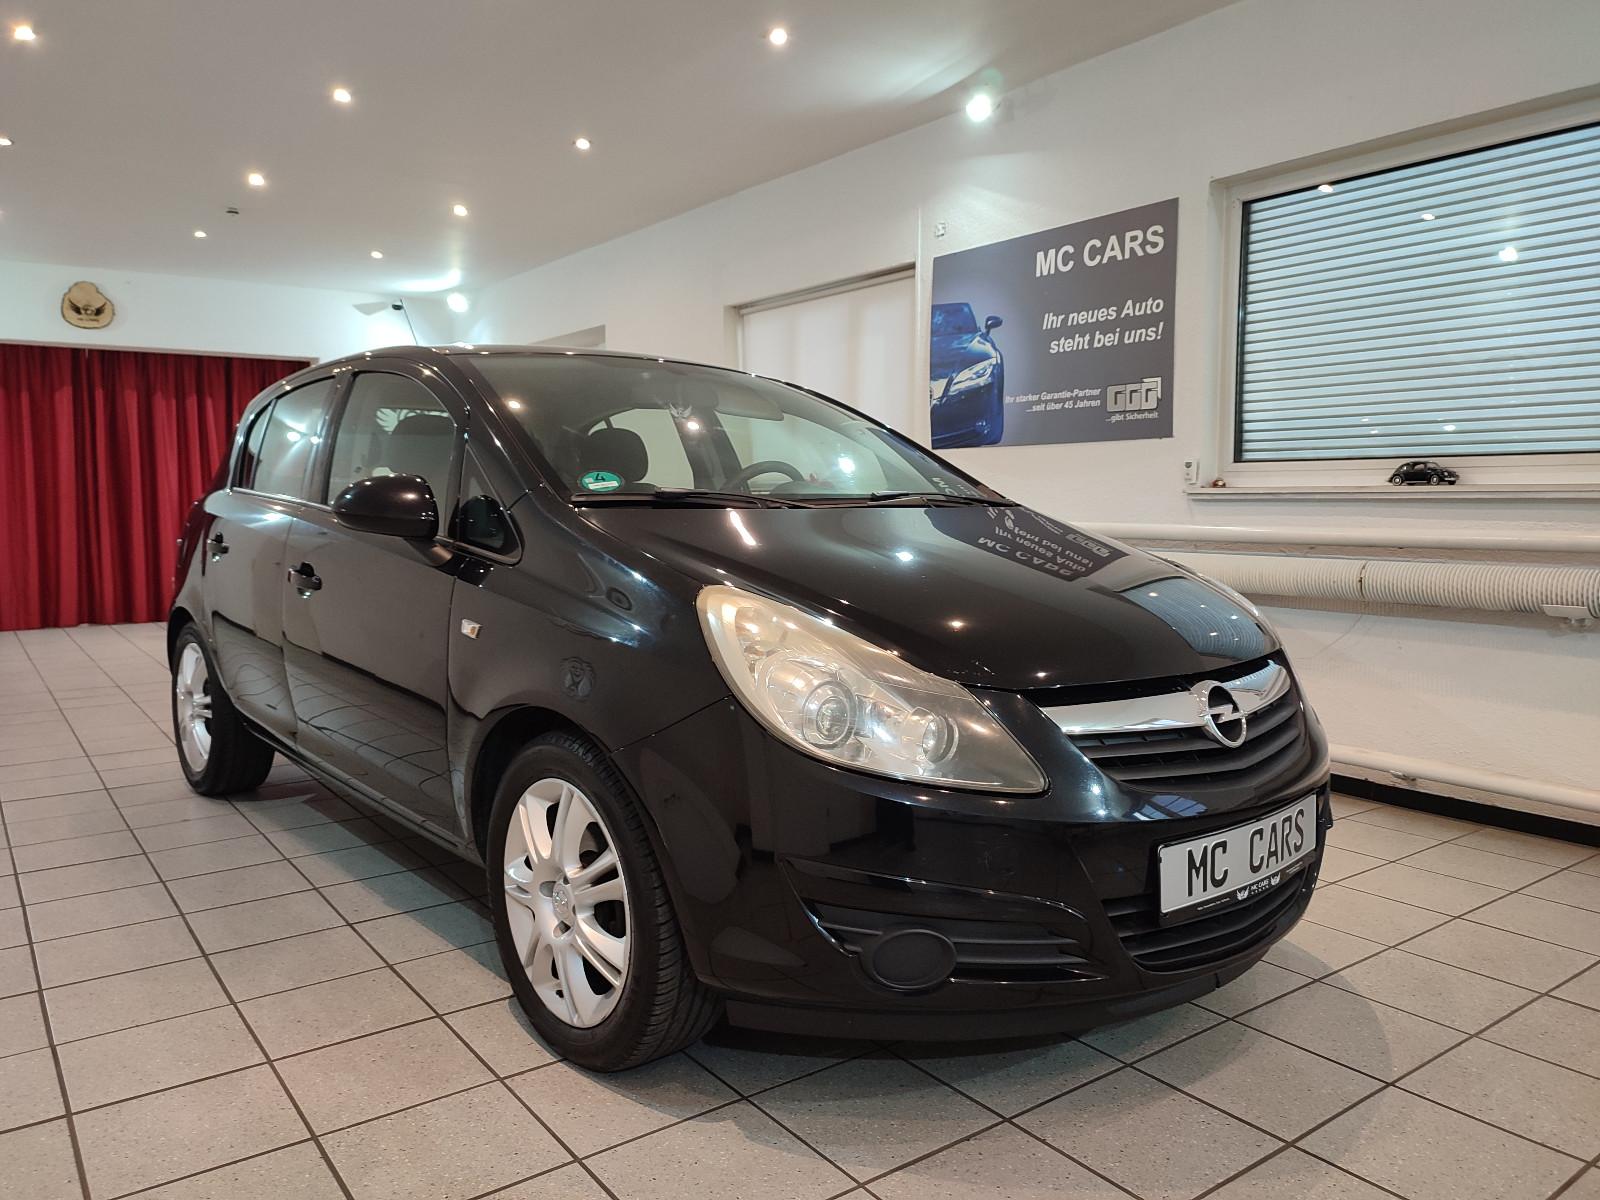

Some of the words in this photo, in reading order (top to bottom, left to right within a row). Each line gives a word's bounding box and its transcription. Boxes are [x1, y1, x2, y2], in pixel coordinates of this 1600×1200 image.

[1035, 245, 1074, 278] MC
[1083, 225, 1165, 268] CARS
[1042, 312, 1065, 330] Ihr
[1067, 306, 1118, 327] neues
[1121, 297, 1164, 318] Auto
[1049, 333, 1090, 354] steht
[1093, 328, 1120, 349] bei
[1124, 322, 1164, 345] uns!
[1016, 393, 1040, 403] starker
[1040, 388, 1101, 401] Garantie-Partner
[1046, 400, 1063, 411] über
[1064, 400, 1073, 409] 45
[1075, 399, 1101, 409] Jahren
[1125, 411, 1159, 421] Sicherheit
[1187, 840, 1228, 897] MC
[1250, 808, 1305, 874] CARS
